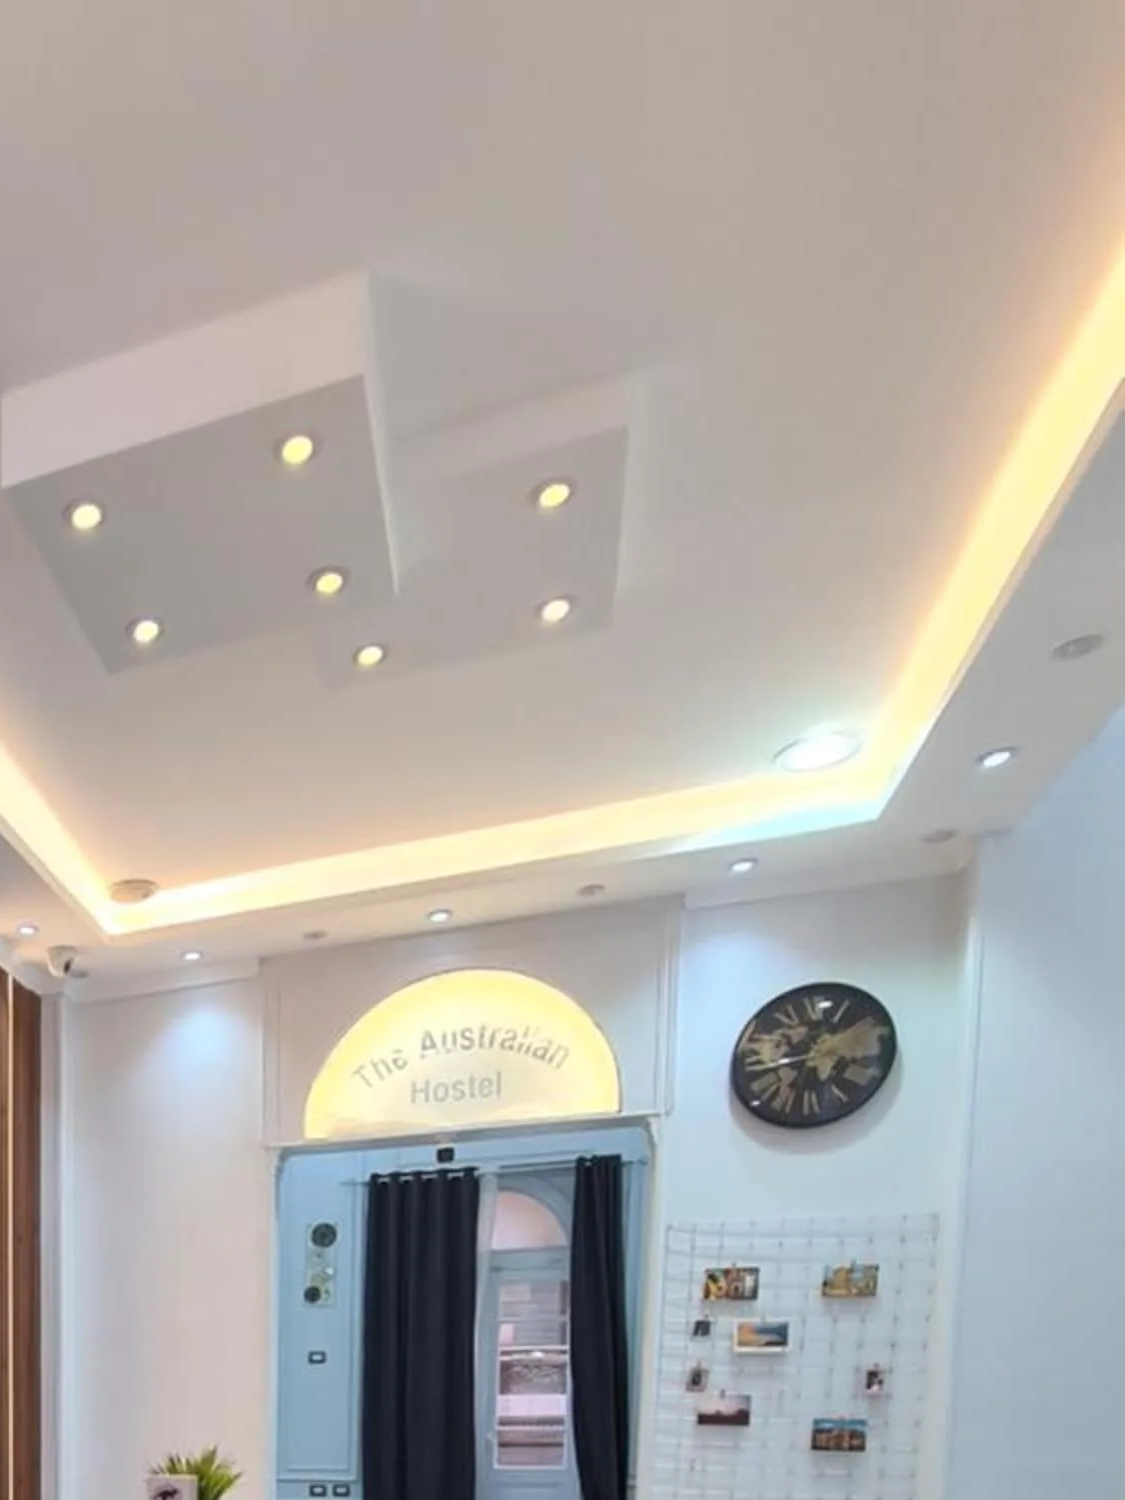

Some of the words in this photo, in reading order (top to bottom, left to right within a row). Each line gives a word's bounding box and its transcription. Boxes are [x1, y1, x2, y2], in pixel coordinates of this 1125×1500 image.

[352, 1049, 409, 1089] The
[420, 1024, 570, 1070] Australian
[411, 1071, 503, 1104] Hostel
